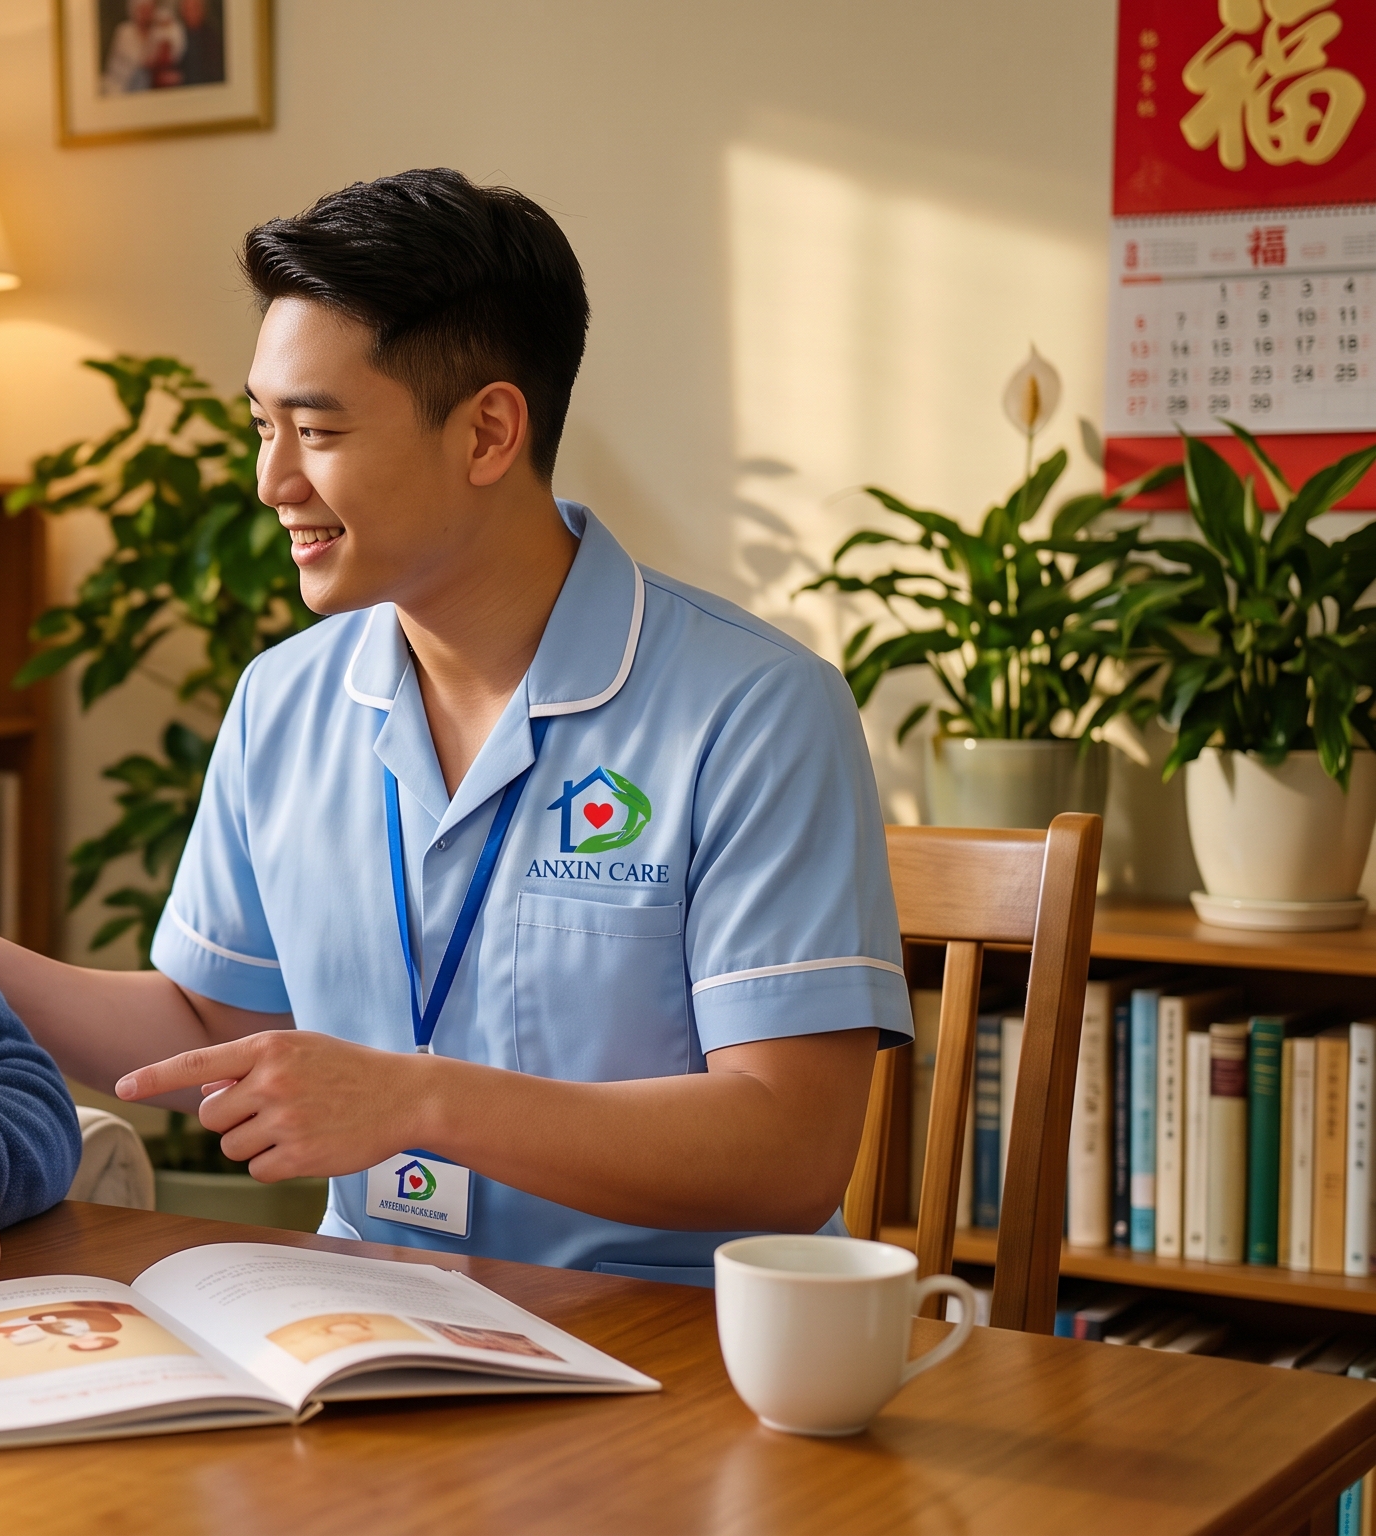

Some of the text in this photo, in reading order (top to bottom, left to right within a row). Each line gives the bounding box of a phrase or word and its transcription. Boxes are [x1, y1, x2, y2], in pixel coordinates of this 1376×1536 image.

[1179, 0, 1366, 171] 福
[1247, 225, 1288, 268] 福
[1220, 277, 1356, 300] 1 2 3 4
[1176, 311, 1186, 330] 7
[1259, 308, 1270, 328] 9
[1296, 307, 1316, 327] 10
[1339, 306, 1357, 325] 11
[1172, 340, 1190, 357] 14
[1295, 335, 1315, 355] 17
[1128, 369, 1147, 387] 20
[1168, 368, 1187, 387] 21
[1209, 366, 1231, 385] 22
[1251, 365, 1272, 384] 23
[1292, 364, 1314, 383] 24
[1127, 397, 1147, 415] 27
[1249, 394, 1271, 413] 30
[526, 860, 669, 883] ANXIN CARE
